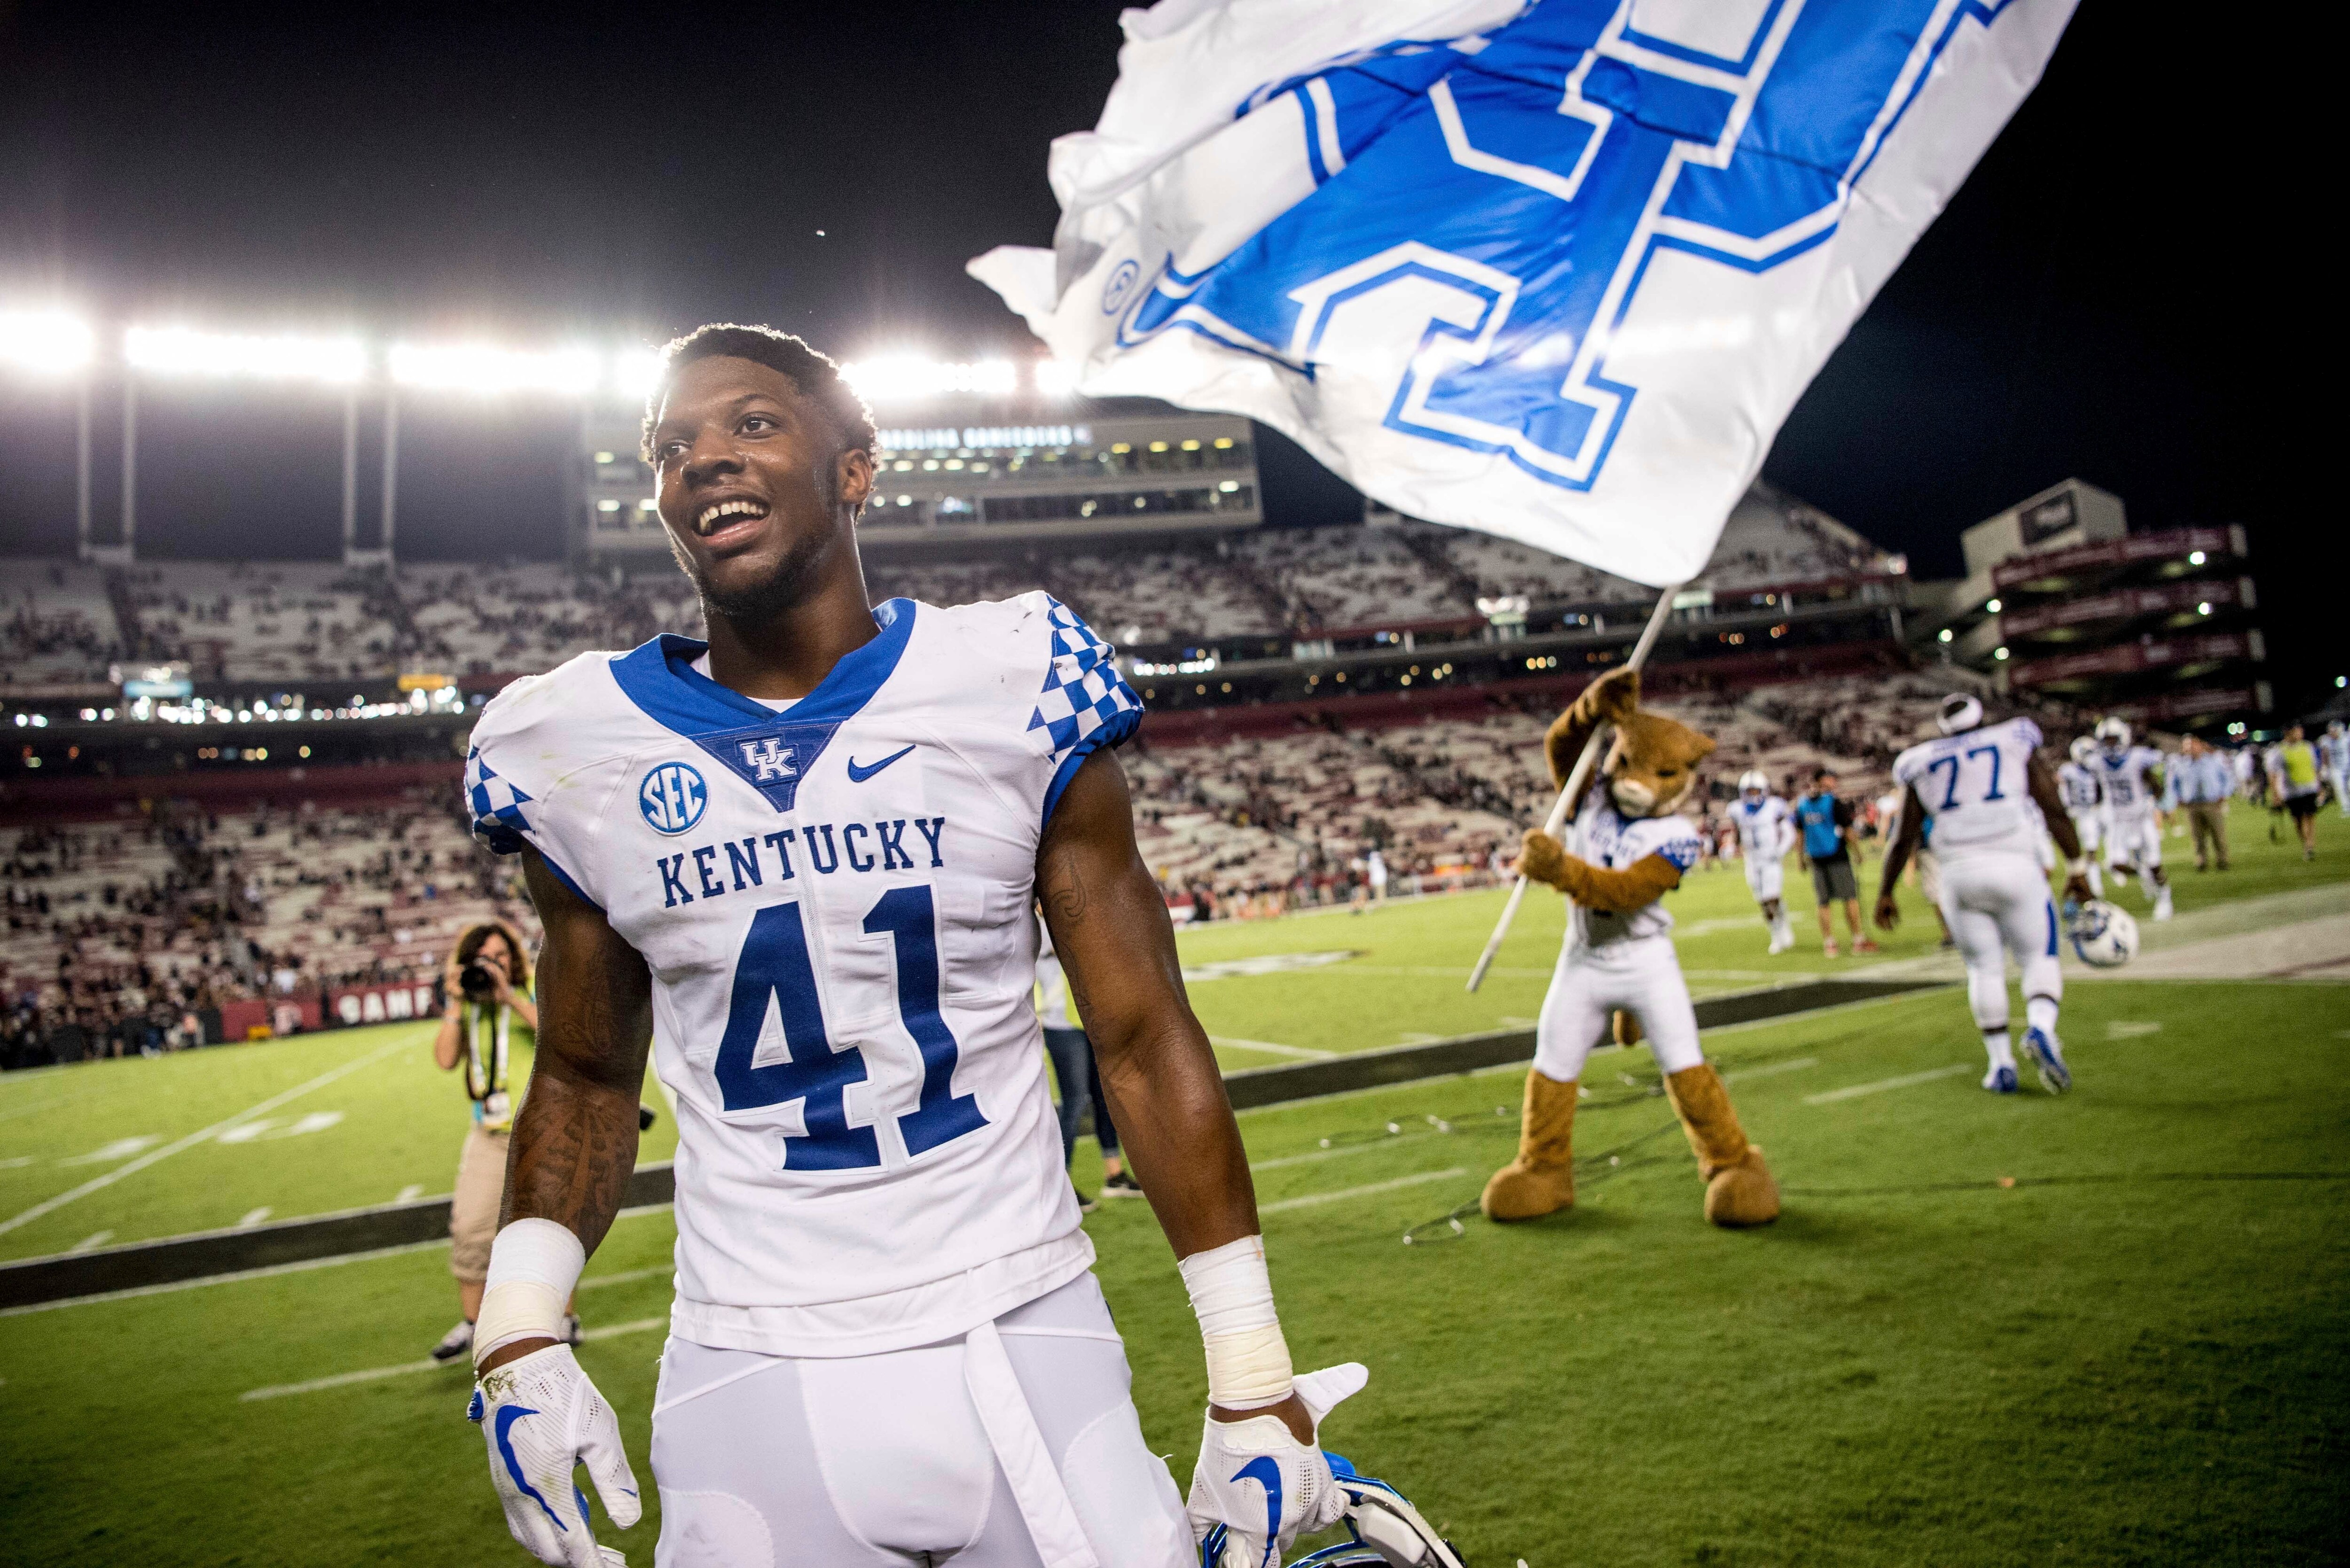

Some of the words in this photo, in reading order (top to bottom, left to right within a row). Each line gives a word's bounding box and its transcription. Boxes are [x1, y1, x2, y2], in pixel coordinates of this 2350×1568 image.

[739, 737, 797, 782] UK
[1928, 744, 2005, 810] 77
[642, 766, 704, 829] SEC
[658, 817, 945, 908] KENTUCKY
[713, 881, 995, 1172] 41
